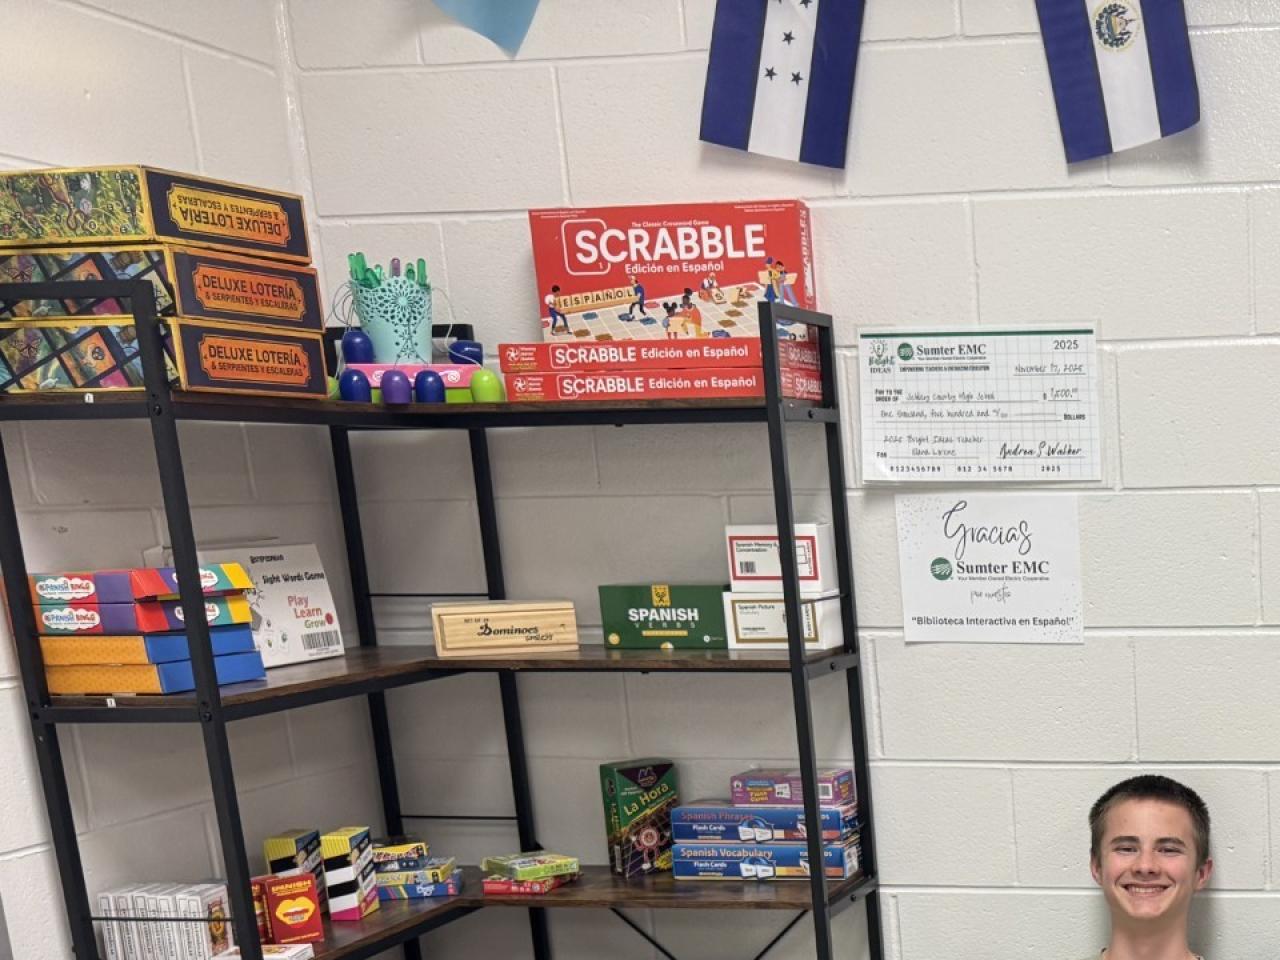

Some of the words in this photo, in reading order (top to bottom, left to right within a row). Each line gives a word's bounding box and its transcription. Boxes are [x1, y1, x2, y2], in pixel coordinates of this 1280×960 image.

[177, 194, 222, 209] ESCALERAS
[223, 203, 229, 211] Y
[180, 206, 234, 231] LOTERÍA
[230, 203, 273, 220] SERPIENTES
[236, 217, 281, 236] DELUXE
[574, 223, 766, 265] SCRABBLE
[625, 262, 664, 274] Edición
[666, 264, 680, 273] en
[682, 261, 725, 274] Español
[202, 274, 248, 293] DELUXE
[250, 282, 297, 301] LOTERÍA
[212, 292, 254, 305] SERPIENTES
[260, 299, 299, 312] ESCALERAS
[916, 344, 956, 356] Sumter
[958, 343, 987, 355] EMC
[1054, 339, 1080, 350] 2025
[208, 344, 253, 361] DELUXE
[255, 348, 302, 365] LOTERÍA
[555, 347, 637, 364] SCRABBLE
[641, 346, 682, 359] Edición
[684, 347, 701, 358] en
[703, 344, 749, 358] Español
[217, 362, 260, 373] SERPIENTES
[265, 365, 304, 377] ESCALERAS
[563, 377, 645, 394] SCRABBLE
[649, 376, 690, 388] Edición
[693, 377, 709, 388] en
[711, 375, 757, 388] Español
[1000, 443, 1035, 459] Andrea
[941, 499, 1033, 562] Gracias
[956, 561, 1009, 576] Sumter
[1012, 560, 1050, 575] EMC
[262, 574, 281, 585] Sight
[281, 573, 304, 583] Words
[304, 571, 325, 581] Game
[287, 595, 309, 609] Play
[294, 607, 322, 619] Learn
[628, 607, 700, 622] SPANISH
[304, 619, 327, 629] Grow
[633, 621, 697, 629] VERBS
[966, 616, 1018, 626] Interactiva
[1018, 618, 1031, 626] en
[476, 622, 539, 637] Dominoes
[623, 802, 640, 817] La
[639, 783, 670, 807] Hora
[681, 812, 718, 822] Spanish
[719, 811, 754, 821] Phrases
[680, 848, 719, 858] Spanish
[719, 847, 773, 859] Vocabulary
